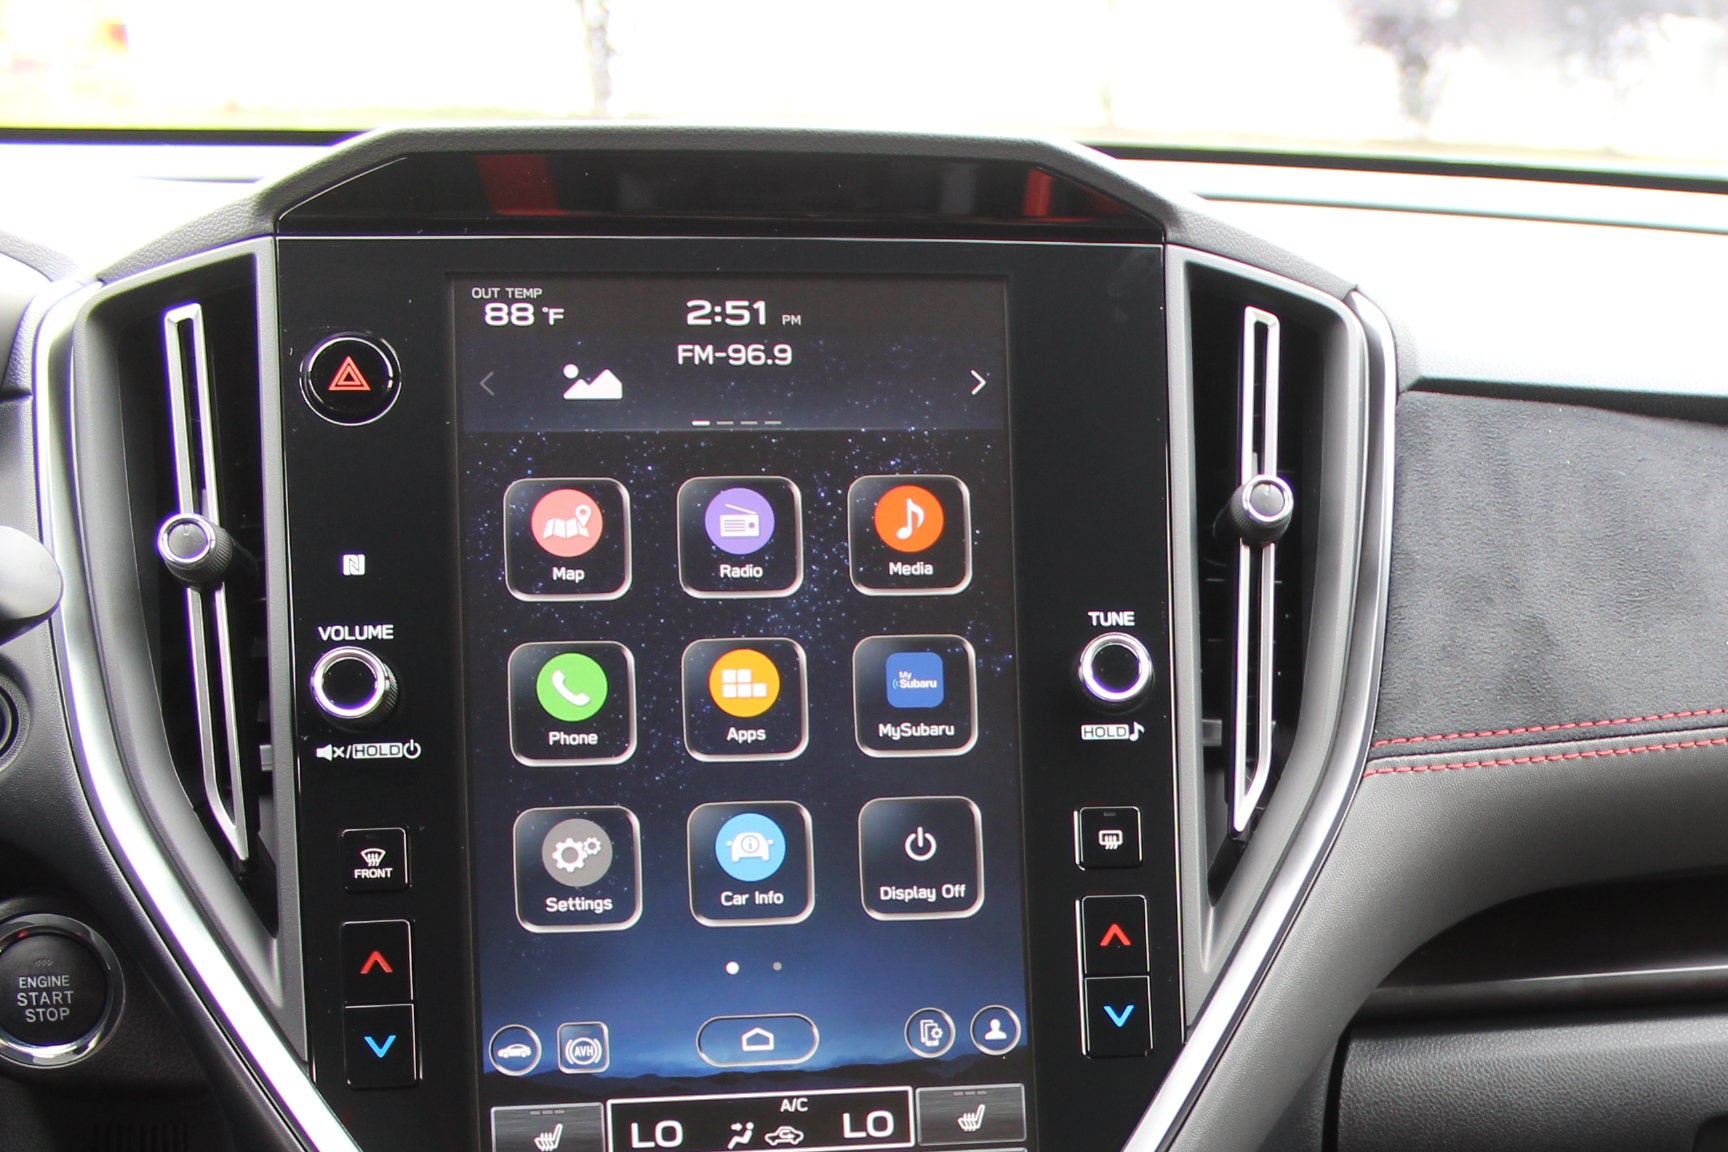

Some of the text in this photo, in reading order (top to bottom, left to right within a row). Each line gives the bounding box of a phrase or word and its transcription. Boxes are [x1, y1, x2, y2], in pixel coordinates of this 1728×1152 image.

[472, 288, 542, 298] OUT TEMP
[485, 303, 534, 325] 88
[687, 300, 801, 325] 2:51 PM
[678, 344, 792, 365] FM-96.9
[553, 567, 584, 583] Map
[720, 564, 763, 577] Radio
[889, 562, 933, 575] Media
[1088, 611, 1135, 626] TUNE
[318, 625, 393, 640] VOLUME
[899, 679, 937, 689] Subaru
[549, 732, 598, 745] Phone
[727, 727, 766, 743] Apps
[879, 723, 954, 740] MySubaru
[355, 866, 392, 878] FRONT
[721, 891, 783, 905] Car Info
[880, 884, 965, 902] Display Off
[546, 897, 612, 913] Settings
[19, 975, 70, 989] ENGINE
[17, 990, 74, 1007] START
[25, 1007, 70, 1023] STOP
[574, 1044, 595, 1059] AVH
[780, 1099, 808, 1113] A/C
[843, 1111, 894, 1138] LO
[631, 1120, 683, 1148] LO
